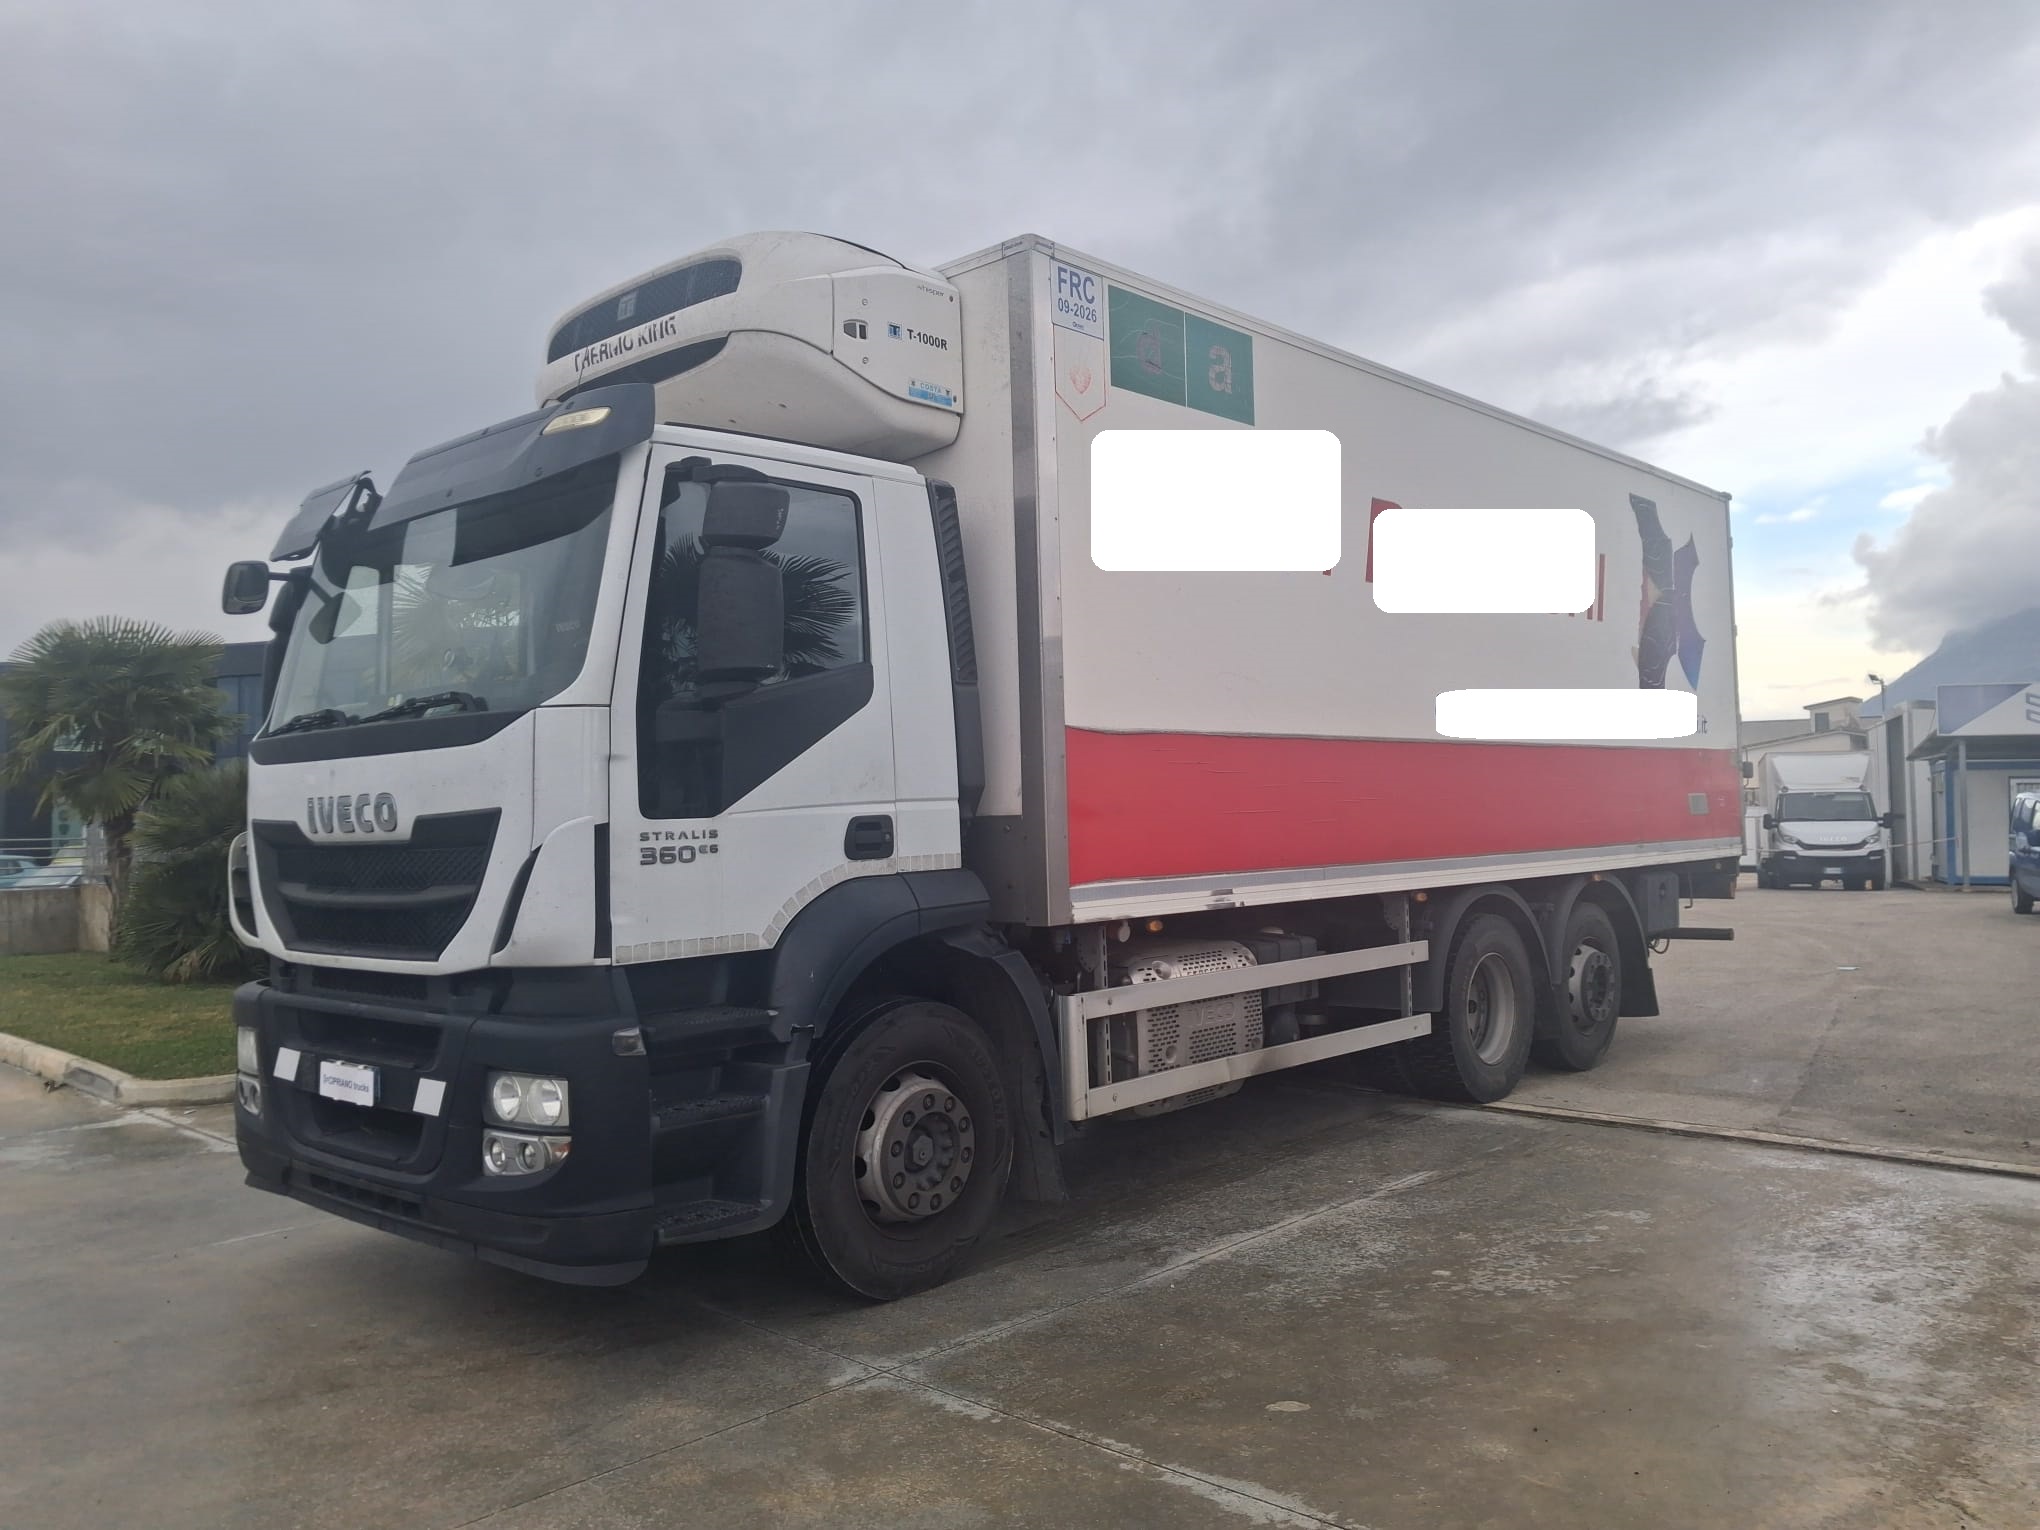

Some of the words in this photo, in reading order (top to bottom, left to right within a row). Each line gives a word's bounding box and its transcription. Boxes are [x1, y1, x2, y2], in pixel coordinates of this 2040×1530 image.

[1058, 266, 1095, 304] FRC
[1057, 297, 1097, 323] 09-2026
[907, 328, 948, 351] T-1000R
[1208, 344, 1232, 394] a
[307, 792, 398, 834] IVECO
[639, 829, 719, 841] STRALIS
[640, 845, 697, 866] 360
